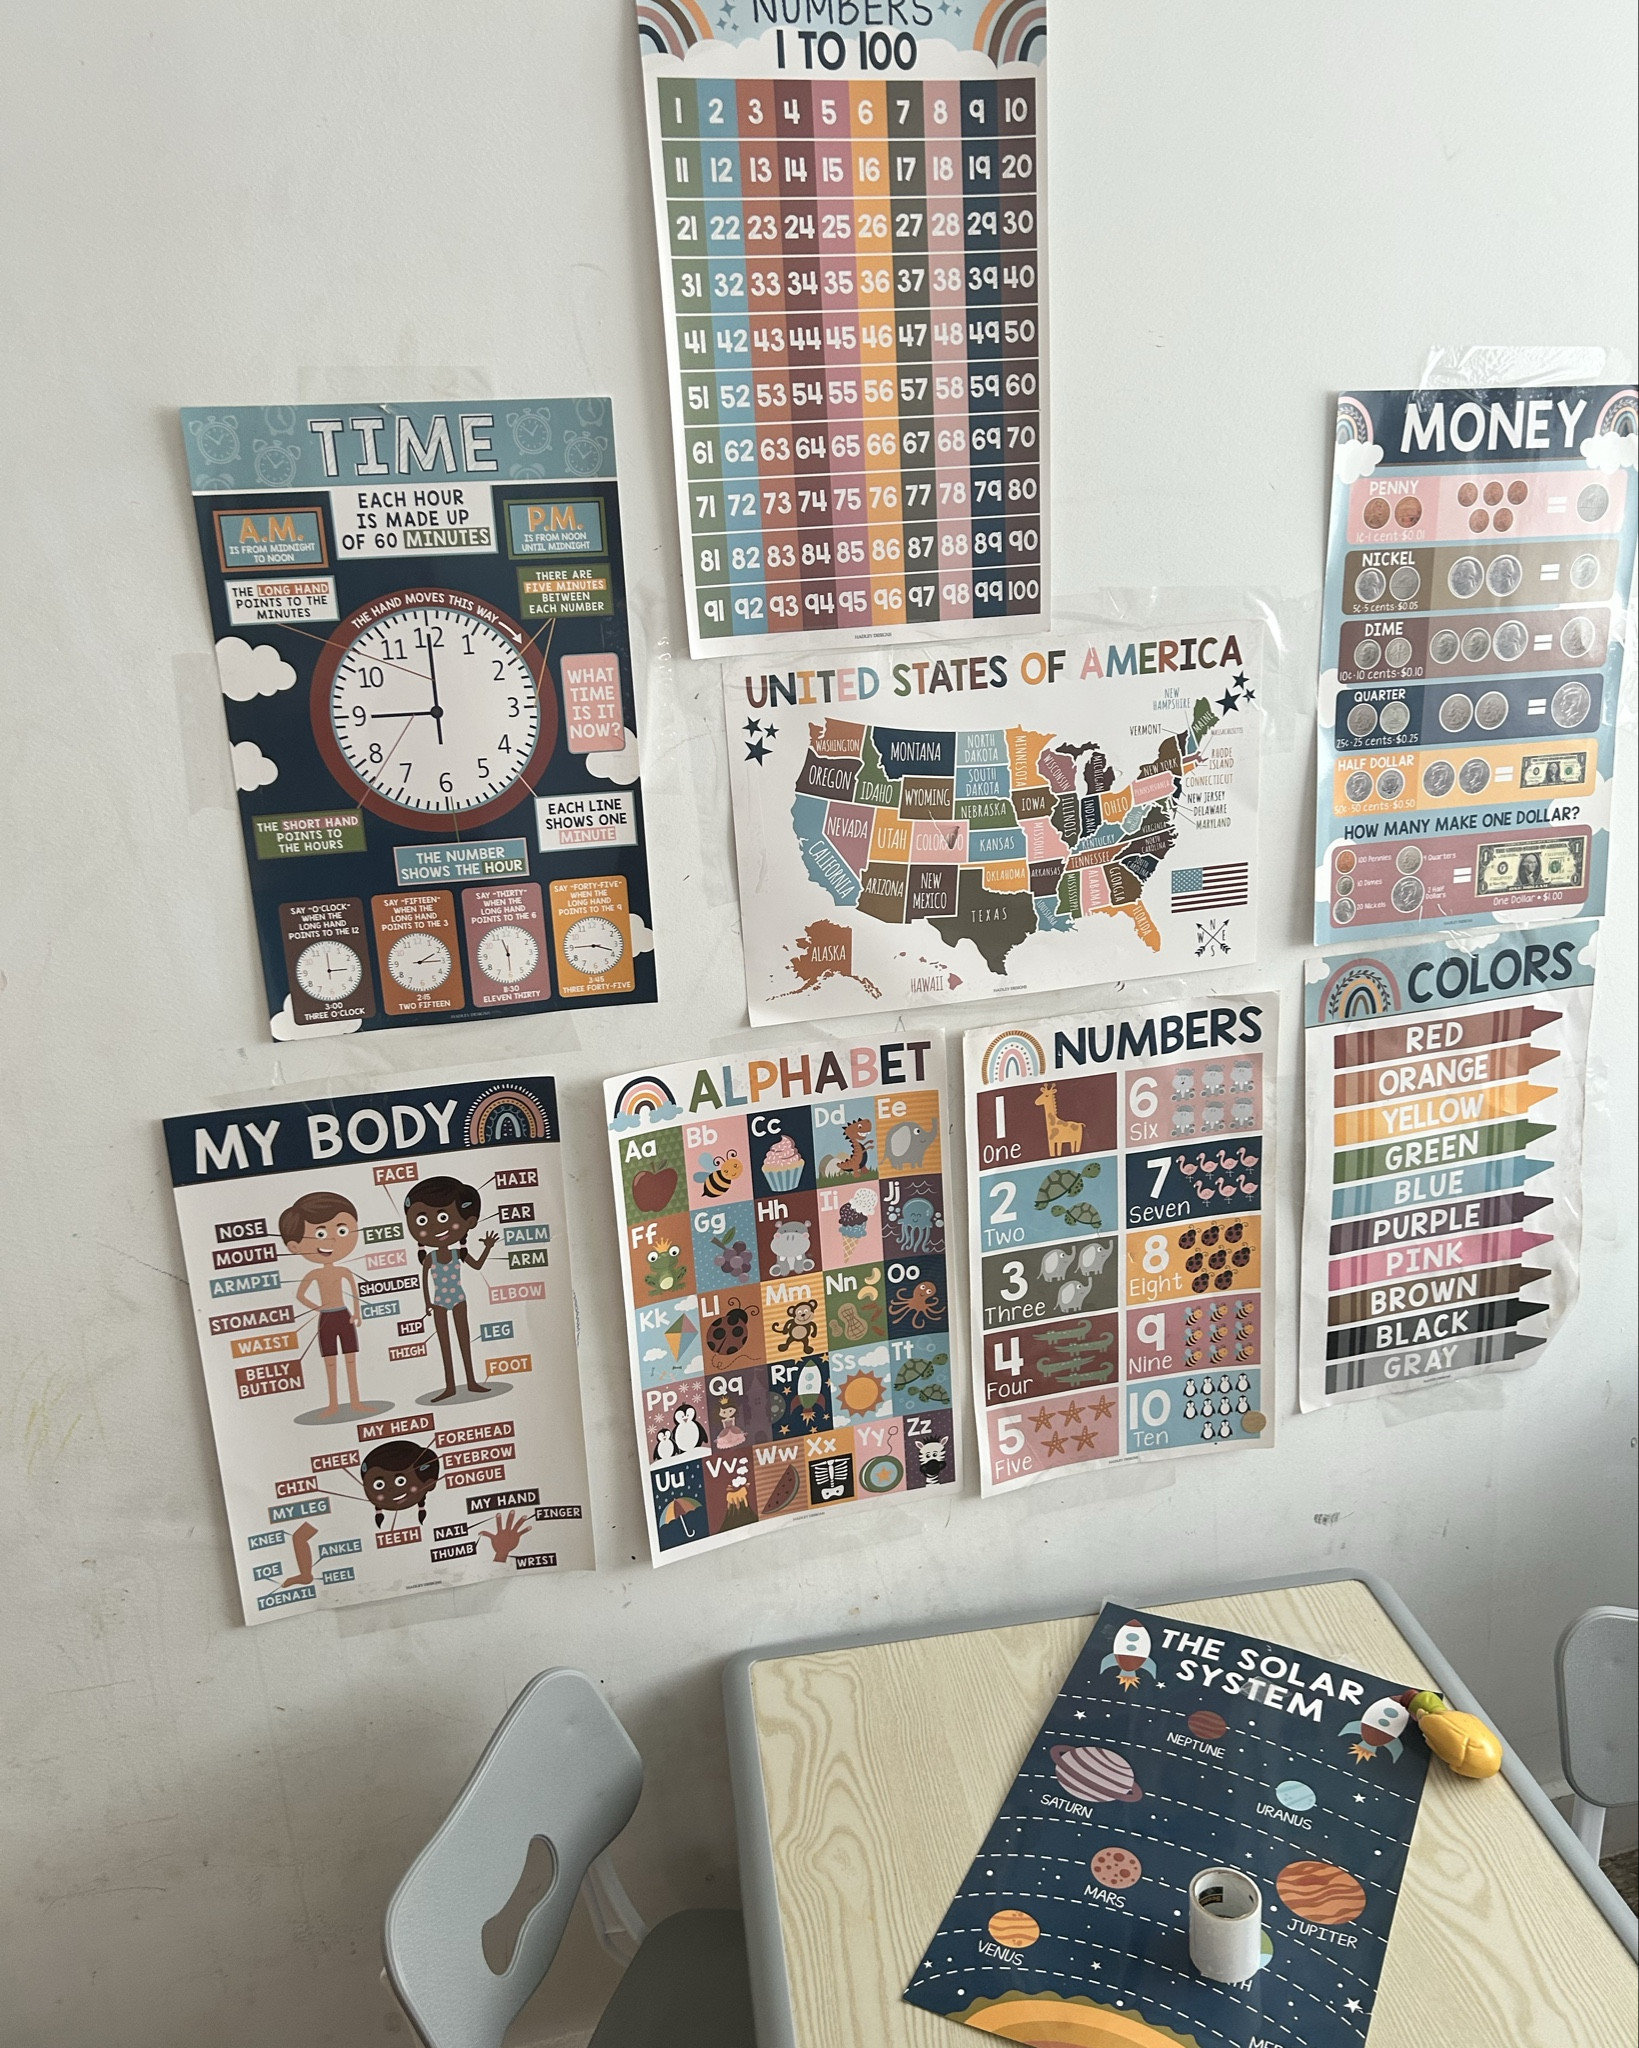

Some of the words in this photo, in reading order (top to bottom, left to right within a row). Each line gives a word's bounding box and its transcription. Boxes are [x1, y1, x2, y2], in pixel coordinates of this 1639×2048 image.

[753, 0, 933, 25] NUMBERS
[798, 31, 845, 70] TO
[860, 31, 917, 70] 100
[675, 98, 682, 123] 1
[709, 98, 724, 124] 2
[748, 99, 763, 124] 3
[784, 99, 799, 124] 4
[822, 100, 837, 124] 5
[858, 100, 873, 124] 6
[897, 100, 910, 124] 7
[934, 100, 947, 124] 8
[969, 100, 984, 123] 9
[1005, 98, 1028, 122] 10
[1401, 399, 1587, 453] MONEY
[308, 414, 498, 477] TIME
[692, 440, 713, 464] 61
[724, 439, 754, 462] 62
[761, 438, 790, 461] 63
[796, 436, 826, 459] 64
[831, 435, 860, 458] 65
[867, 433, 896, 455] 66
[903, 431, 930, 454] 67
[938, 430, 965, 452] 68
[972, 427, 1001, 449] 69
[1007, 425, 1035, 447] 70
[1369, 480, 1419, 495] PENNY
[358, 491, 409, 509] EACH
[414, 490, 464, 506] HOUR
[358, 514, 376, 529] IS
[381, 511, 436, 527] MADE
[448, 510, 469, 524] UP
[528, 506, 584, 531] P.M.
[240, 516, 304, 543] A.M.
[342, 534, 370, 550] OF
[374, 533, 397, 549] 60
[405, 529, 490, 548] MINUTES
[1362, 551, 1415, 566] NICKEL
[232, 587, 253, 597] THE
[258, 584, 290, 596] LONG
[294, 583, 328, 594] HAND
[236, 596, 281, 608] POINTS
[286, 596, 301, 606] TO
[305, 595, 328, 606] THE
[351, 612, 372, 629] THE
[370, 597, 402, 617] HAND
[405, 592, 445, 604] MOVES
[449, 594, 474, 611] THIS
[476, 605, 500, 623] WAY
[257, 607, 310, 619] MINUTES
[1365, 622, 1403, 635] DIME
[567, 667, 614, 684] WHAT
[746, 667, 879, 708] UNITED
[893, 655, 1007, 697] STATES
[1021, 650, 1066, 685] OF
[1080, 634, 1243, 680] AMERICA
[570, 686, 615, 702] TIME
[1354, 689, 1405, 702] QUARTER
[572, 705, 590, 720] IS
[597, 704, 615, 718] IT
[570, 722, 620, 739] NOW?
[1130, 724, 1161, 735] VERMONT
[891, 743, 941, 761] MONTANA
[1338, 758, 1366, 771] HALF
[1370, 755, 1414, 768] DOLLAR
[809, 765, 852, 790] OREGON
[861, 781, 893, 803] IDAHO
[905, 788, 950, 806] WYOMING
[1187, 793, 1202, 803] NEW
[1204, 791, 1225, 802] JERSEY
[549, 801, 585, 815] EACH
[589, 799, 621, 812] LINE
[1021, 797, 1045, 811] IOWA
[1193, 805, 1227, 816] DELAWARE
[546, 816, 594, 829] SHOWS
[599, 813, 627, 826] ONE
[1344, 824, 1379, 840] HOW
[1384, 820, 1430, 835] MANY
[1435, 815, 1477, 831] MAKE
[1483, 812, 1511, 827] ONE
[1516, 807, 1580, 824] DOLLAR?
[560, 828, 615, 843] MINUTE
[979, 835, 1015, 852] KANSAS
[971, 907, 1008, 923] TEXAS
[811, 944, 846, 961] ALASKA
[1408, 940, 1576, 1003] COLORS
[911, 976, 944, 993] HAWAII
[419, 1001, 450, 1009] FIFTEEN
[484, 994, 512, 1003] ELEVEN
[514, 990, 541, 999] THIRTY
[1055, 1006, 1262, 1069] NUMBERS
[1406, 1022, 1463, 1052] RED
[689, 1041, 931, 1113] ALPHABET
[1379, 1055, 1488, 1097] ORANGE
[1129, 1077, 1158, 1118] 6
[995, 1096, 1005, 1139] 1
[1381, 1093, 1484, 1134] YELLOW
[195, 1120, 280, 1174] MY
[307, 1099, 458, 1160] BODY
[625, 1140, 656, 1163] Aa
[686, 1126, 718, 1148] Bb
[751, 1116, 781, 1137] Cc
[815, 1105, 845, 1128] Dd
[878, 1098, 907, 1119] Ee
[1130, 1123, 1158, 1141] Six
[984, 1143, 1021, 1163] One
[1385, 1131, 1478, 1171] GREEN
[376, 1166, 415, 1182] FACE
[497, 1172, 537, 1186] HAIR
[1147, 1157, 1172, 1199] 7
[1394, 1170, 1463, 1205] BLUE
[989, 1181, 1017, 1224] 2
[1130, 1201, 1190, 1224] Seven
[501, 1207, 531, 1220] EAR
[1373, 1203, 1480, 1243] PURPLE
[220, 1222, 263, 1240] NOSE
[365, 1226, 401, 1242] EYES
[506, 1227, 548, 1242] PALM
[984, 1226, 1025, 1247] Two
[216, 1246, 274, 1265] MOUTH
[367, 1251, 405, 1268] NECK
[511, 1252, 545, 1266] ARM
[1142, 1235, 1169, 1273] 8
[1386, 1241, 1462, 1275] PINK
[360, 1277, 418, 1295] SHOULDER
[1000, 1261, 1028, 1301] 3
[1130, 1273, 1183, 1300] Eight
[491, 1284, 542, 1301] ELBOW
[1371, 1274, 1476, 1315] BROWN
[363, 1303, 398, 1317] CHEST
[985, 1301, 1045, 1325] Three
[212, 1309, 290, 1333] STOMACH
[484, 1323, 511, 1337] LEG
[1376, 1310, 1469, 1349] BLACK
[238, 1335, 291, 1353] WAIST
[489, 1357, 529, 1373] FOOT
[1383, 1345, 1458, 1379] GRAY
[363, 1426, 384, 1438] MY
[390, 1418, 429, 1433] HEAD
[438, 1424, 512, 1445] FOREHEAD
[313, 1453, 358, 1470] CHEEK
[537, 1507, 580, 1519] FINGER
[378, 1530, 419, 1547] TEETH
[518, 1555, 555, 1568] WRIST
[1162, 1629, 1225, 1662] THE
[1237, 1649, 1365, 1706] SOLAR
[1176, 1659, 1323, 1723] SYSTEM
[1167, 1732, 1225, 1759] NEPTUNE
[1040, 1793, 1093, 1818] SATURN
[1256, 1803, 1313, 1831] URANUS
[1083, 1884, 1127, 1909] MARS
[1287, 1919, 1358, 1949] JUPITER
[978, 1940, 1024, 1966] VENUS
